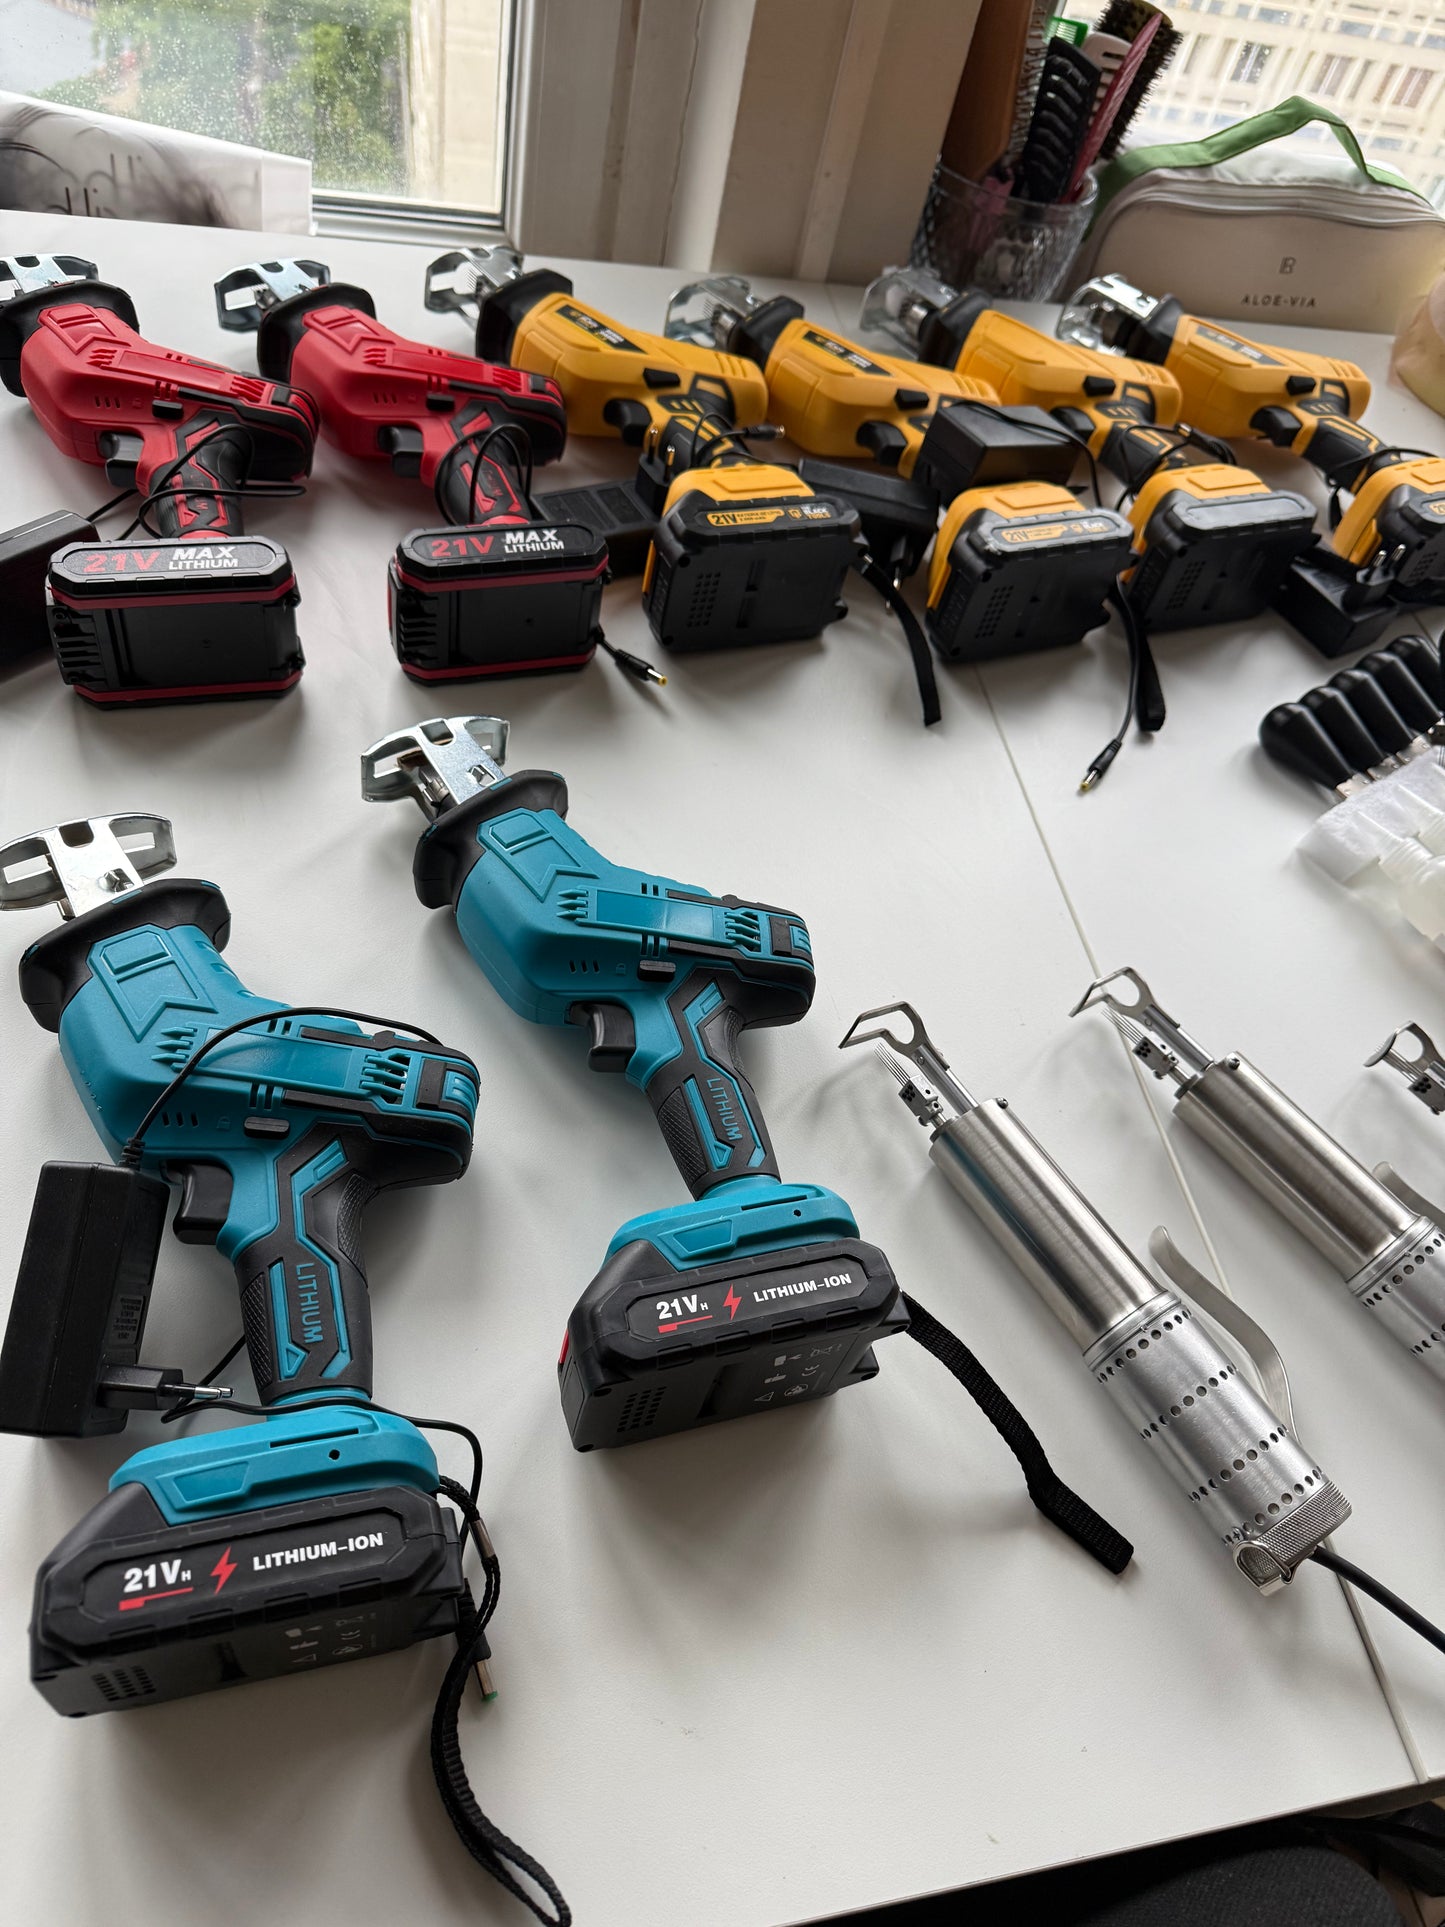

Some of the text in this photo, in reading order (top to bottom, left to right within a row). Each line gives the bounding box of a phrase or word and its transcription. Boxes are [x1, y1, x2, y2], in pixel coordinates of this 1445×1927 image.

[1240, 294, 1317, 308] ALOE-VIA
[710, 513, 738, 526] 21V
[431, 535, 495, 558] 21V
[505, 529, 558, 545] MAX
[172, 546, 236, 561] MAX
[504, 540, 565, 554] LITHIUM
[83, 551, 161, 573] 21V
[168, 558, 239, 571] LITHIUM
[706, 1078, 743, 1141] LITHIUM
[753, 1273, 852, 1303] LITHIUM-ION
[295, 1262, 324, 1344] LITHIUM
[252, 1532, 384, 1571] LITHIUM-ION
